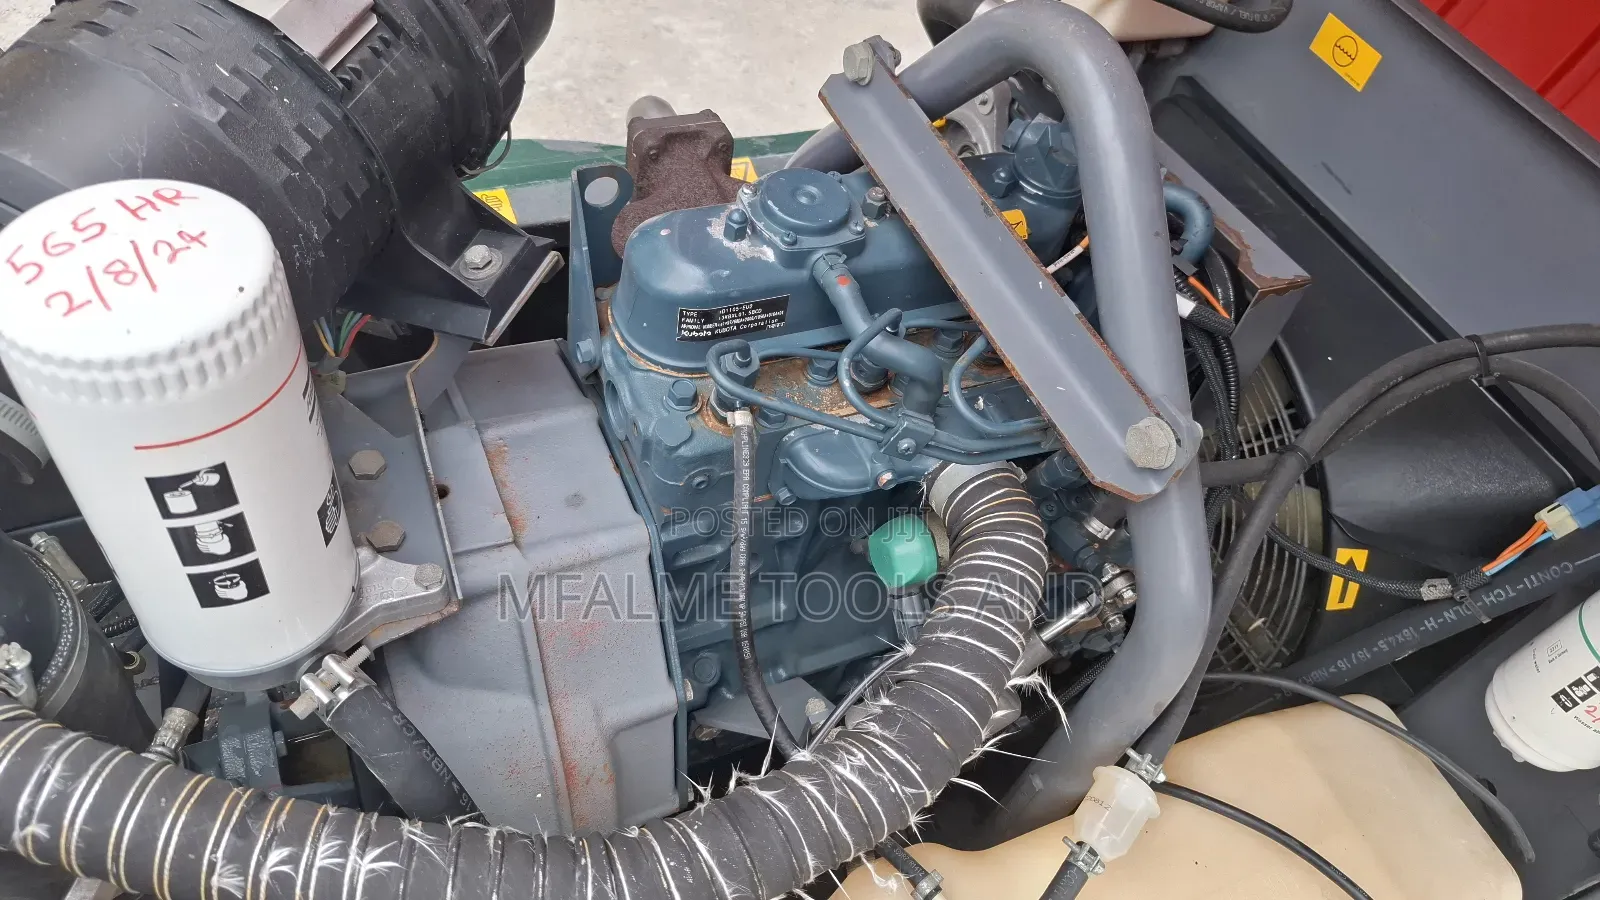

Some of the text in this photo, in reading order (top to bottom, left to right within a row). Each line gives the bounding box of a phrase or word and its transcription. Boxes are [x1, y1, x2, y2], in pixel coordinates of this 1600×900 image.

[6, 187, 199, 285] 565 HR
[44, 230, 208, 318] 2/8/24
[681, 317, 705, 325] FAMILY
[682, 310, 698, 318] TYPE
[714, 325, 738, 335] KUBOTA
[739, 318, 779, 331] Corporation
